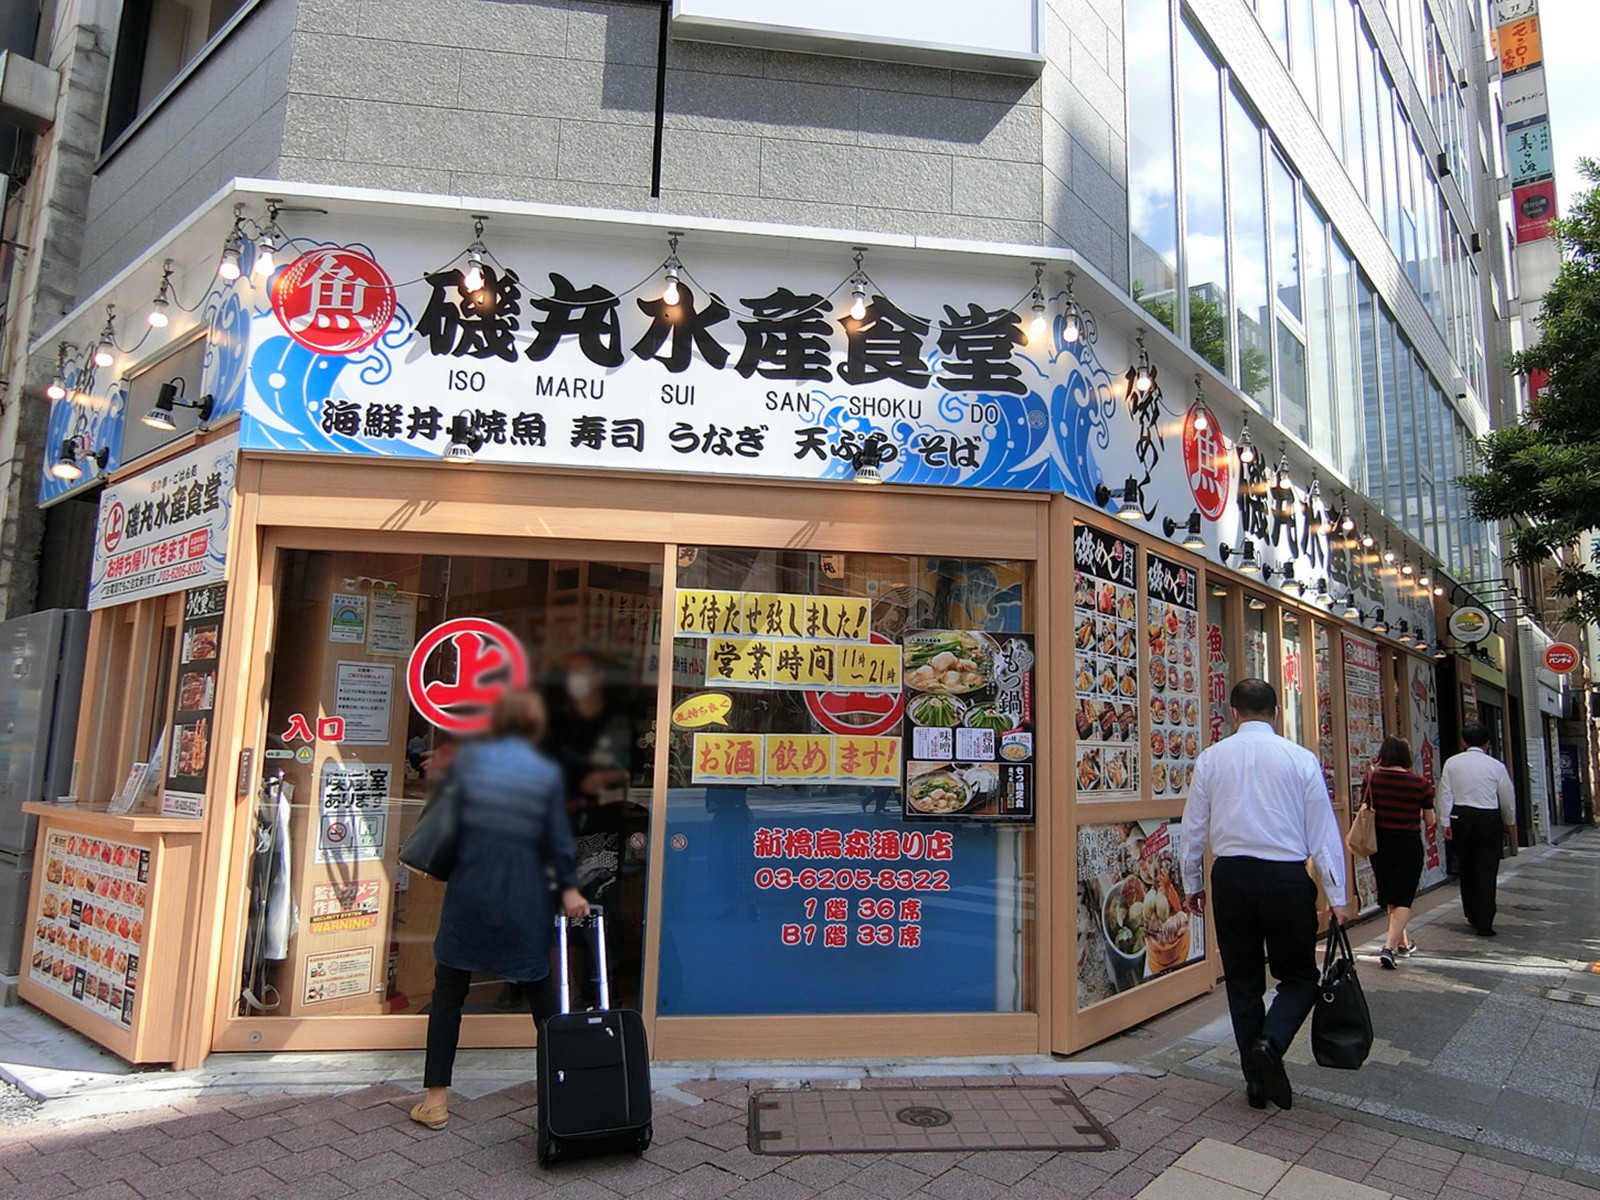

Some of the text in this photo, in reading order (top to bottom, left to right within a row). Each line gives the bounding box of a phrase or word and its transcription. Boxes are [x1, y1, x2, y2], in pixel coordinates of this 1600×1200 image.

[290, 255, 376, 333] 魚
[415, 264, 1029, 396] 磯丸水産食堂
[449, 370, 999, 424] ISO MARU SUI SAN SHOKU DO
[321, 399, 981, 469] 海鮮丼 焼魚 寿司 うなぎ 天ぷら そば
[125, 471, 222, 540] 磯丸水産食堂
[106, 536, 189, 579] お持ち帰りできます
[680, 594, 867, 638] お待たせ致しました!
[713, 642, 835, 680] 営業時間
[1000, 645, 1023, 716] もつ鍋
[282, 713, 345, 742] 入口
[699, 738, 897, 776] お酒飲めます!
[324, 792, 388, 809] あります
[754, 868, 951, 891] 03-6205-8322
[312, 916, 377, 934] WARNING!
